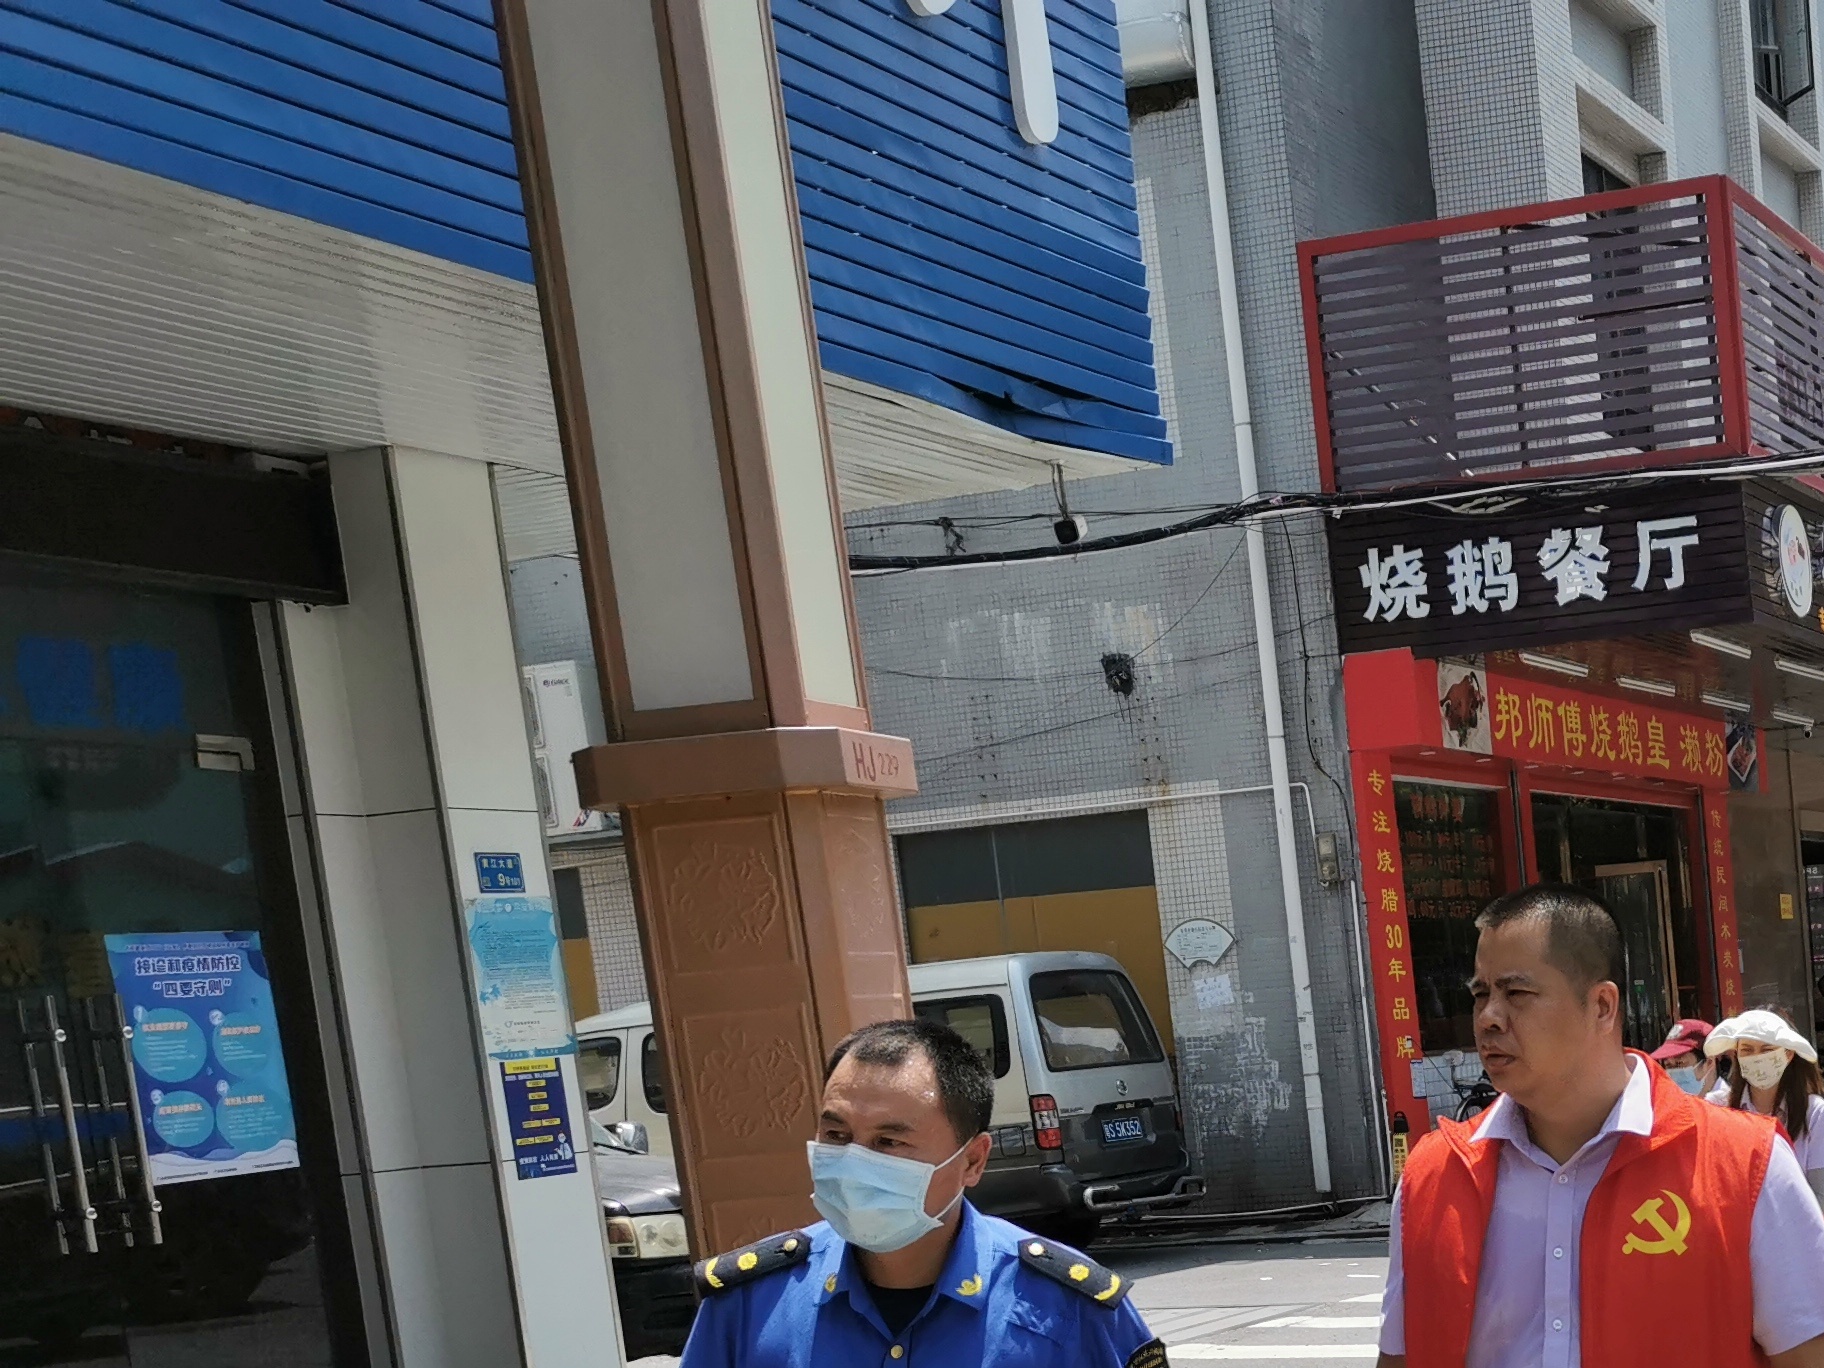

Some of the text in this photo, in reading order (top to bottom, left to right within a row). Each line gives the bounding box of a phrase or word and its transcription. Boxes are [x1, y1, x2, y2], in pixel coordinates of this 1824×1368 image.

[1358, 515, 1699, 622] 烧鹅餐厅
[1495, 687, 1725, 777] 邦师傅烧鹅皇 濑粉
